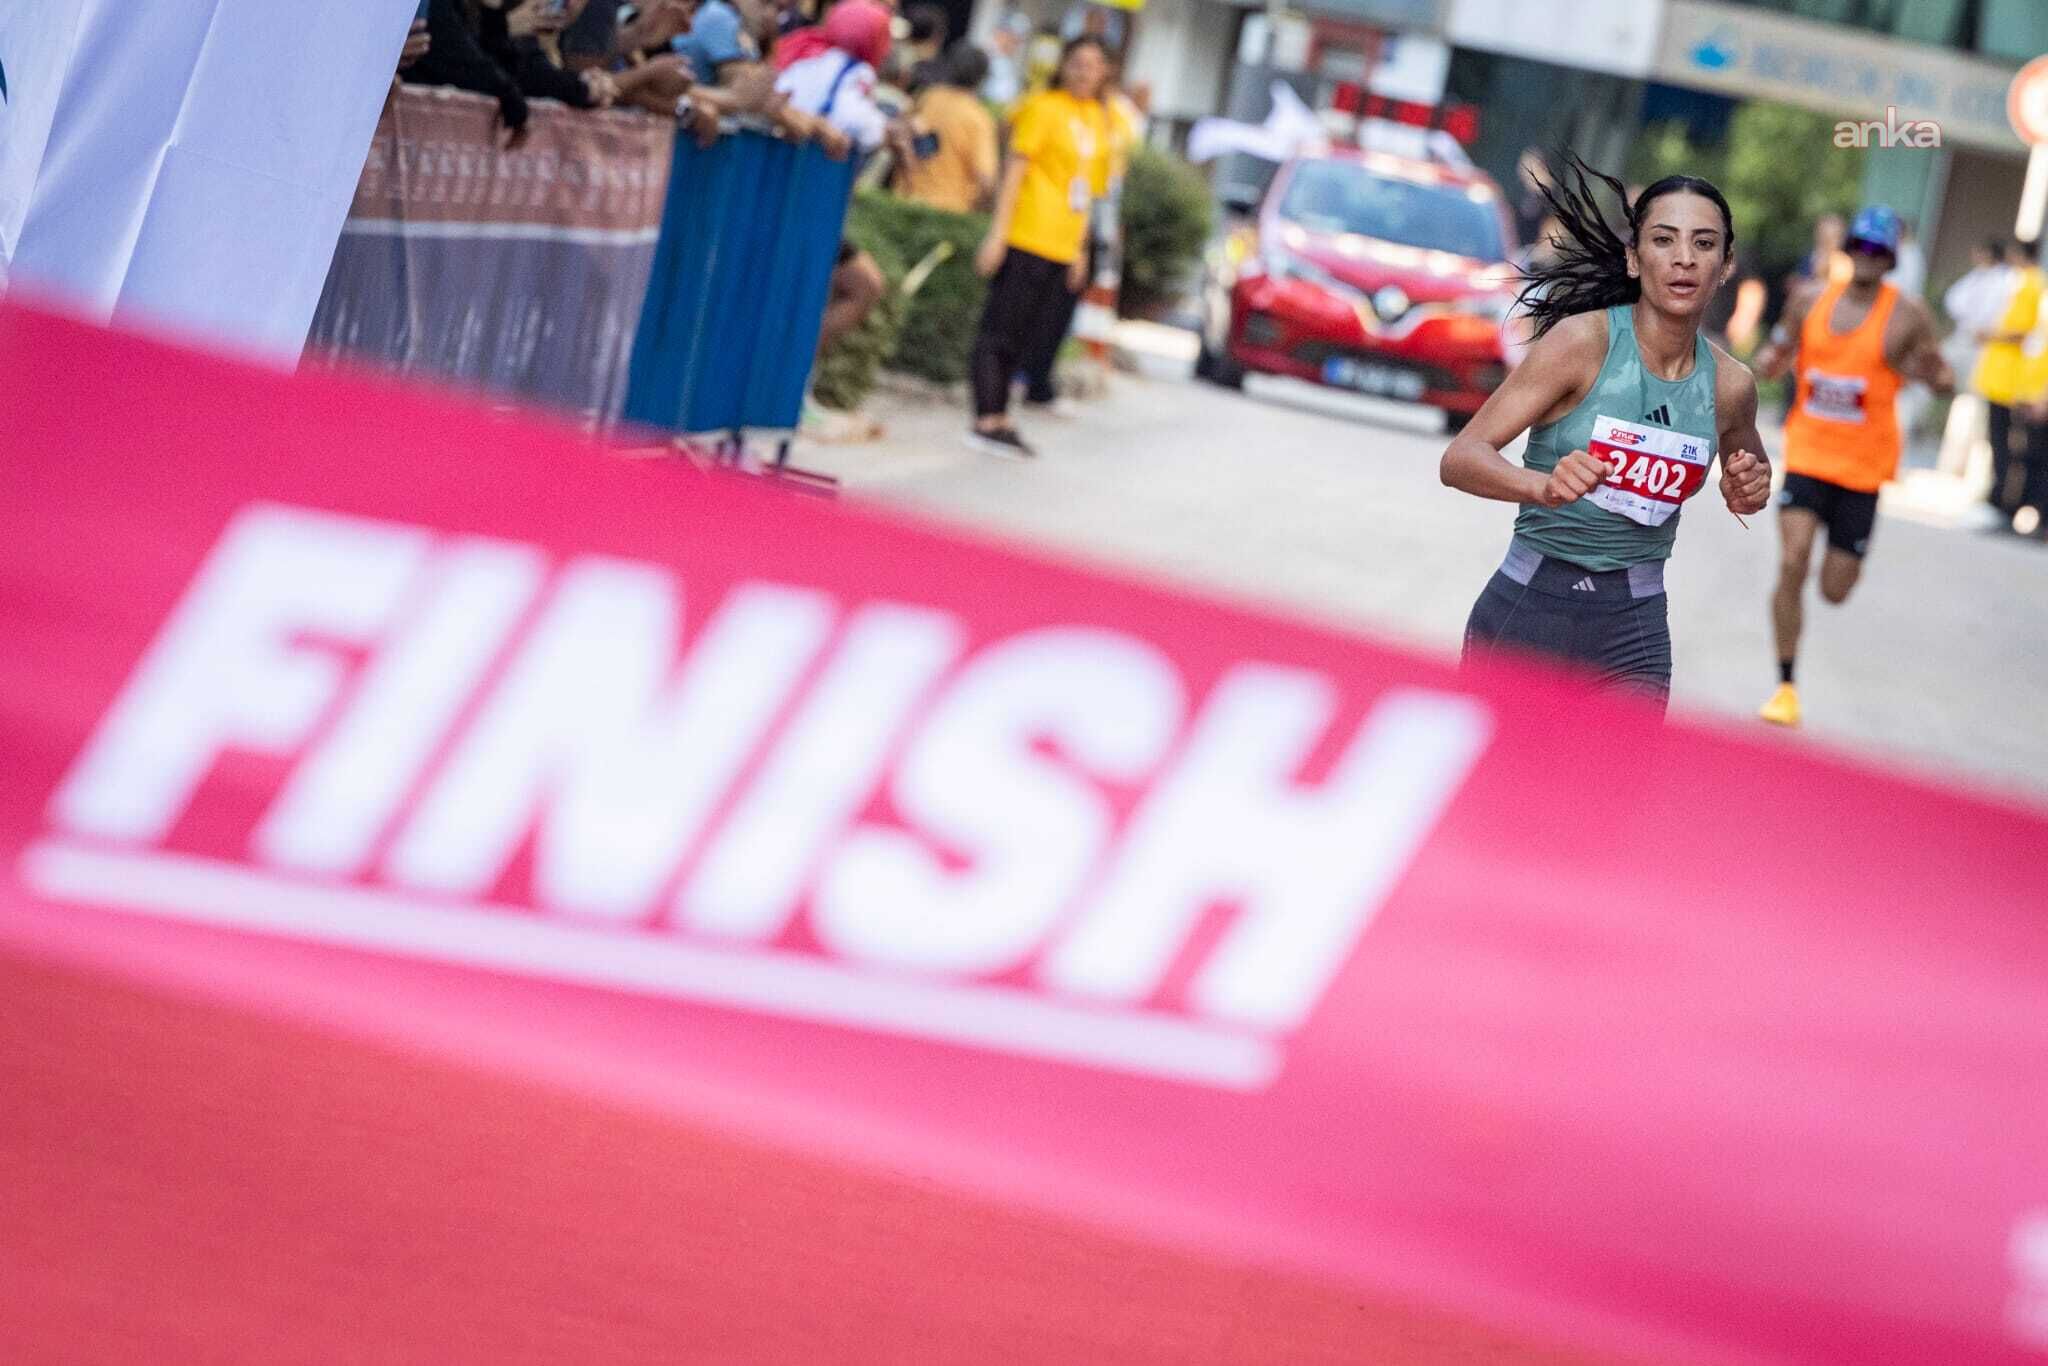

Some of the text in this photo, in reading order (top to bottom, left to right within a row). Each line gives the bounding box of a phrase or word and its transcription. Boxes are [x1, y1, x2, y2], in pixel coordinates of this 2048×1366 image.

[1681, 443, 1698, 455] 21K
[1606, 450, 1686, 498] 2402
[47, 503, 1494, 1036] FINISH
